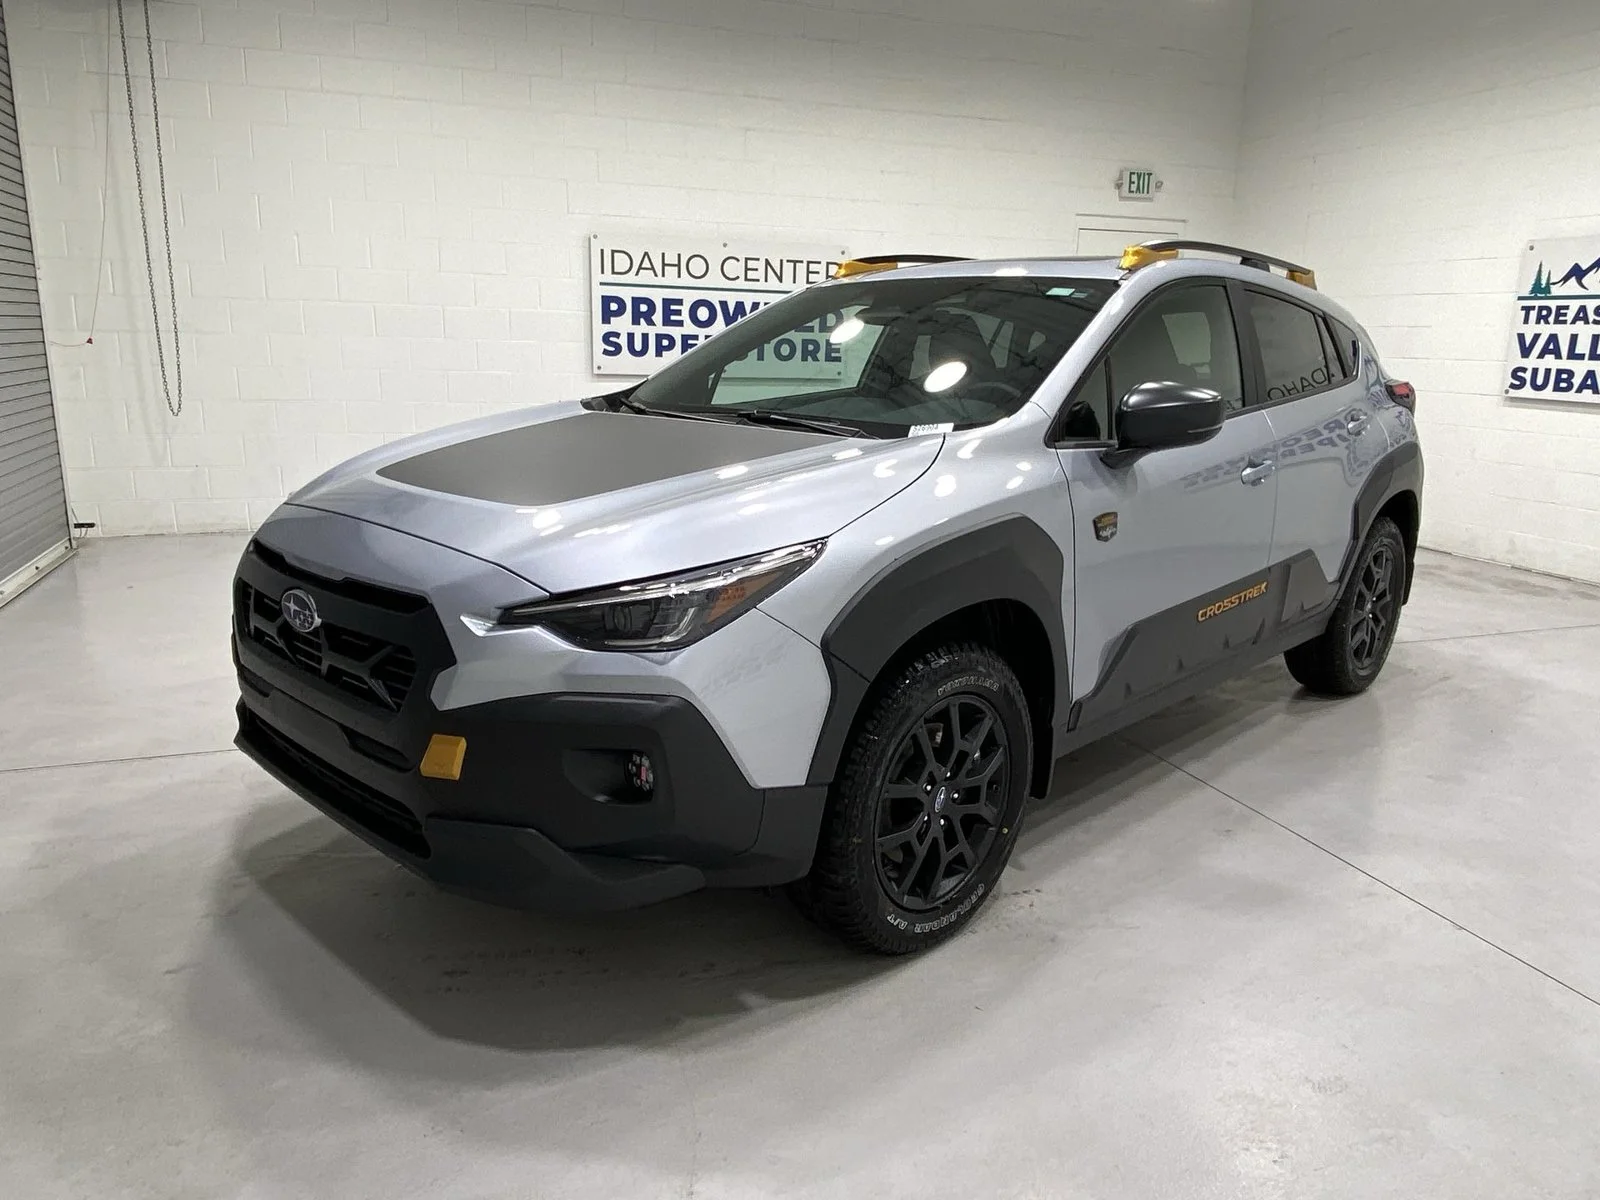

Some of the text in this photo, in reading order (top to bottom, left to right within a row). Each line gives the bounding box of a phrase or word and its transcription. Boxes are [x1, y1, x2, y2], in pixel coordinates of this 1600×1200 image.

[1128, 171, 1153, 194] EXIT
[600, 248, 710, 280] IDAHO
[601, 295, 845, 333] PREOWD
[602, 331, 842, 362] SUPETORE
[1508, 366, 1600, 395] SUBA
[1197, 581, 1268, 623] CROSSTREK
